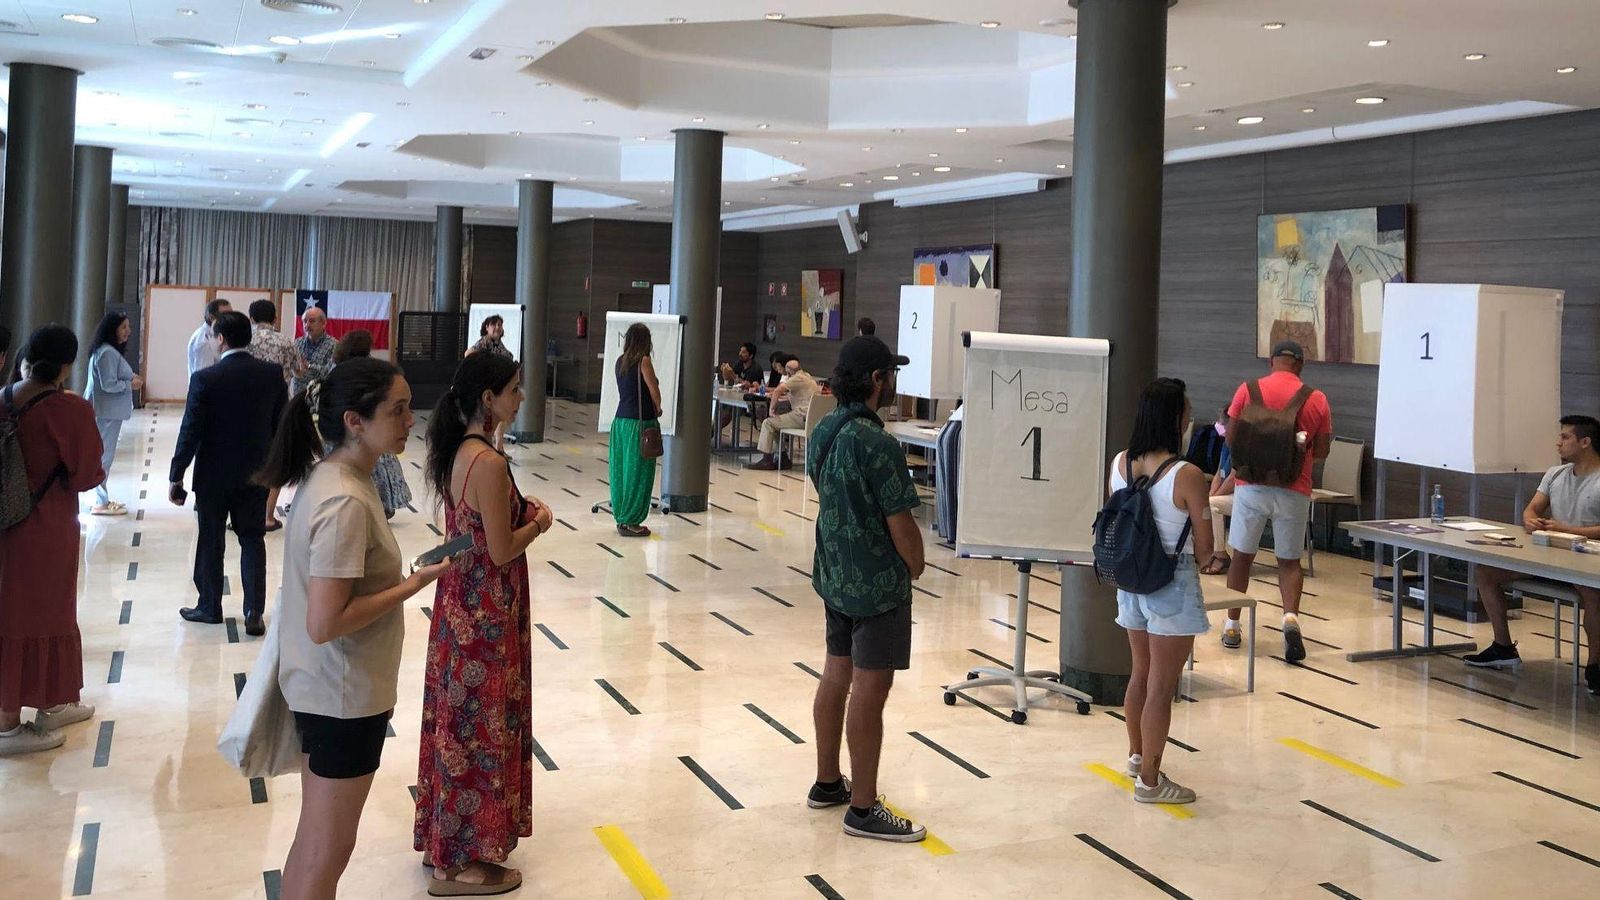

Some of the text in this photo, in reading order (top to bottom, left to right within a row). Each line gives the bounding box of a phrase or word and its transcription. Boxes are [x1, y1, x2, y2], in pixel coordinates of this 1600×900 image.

[911, 311, 918, 330] 2
[1420, 331, 1434, 360] 1
[990, 368, 1069, 414] Mesa
[1020, 426, 1051, 482] 1
